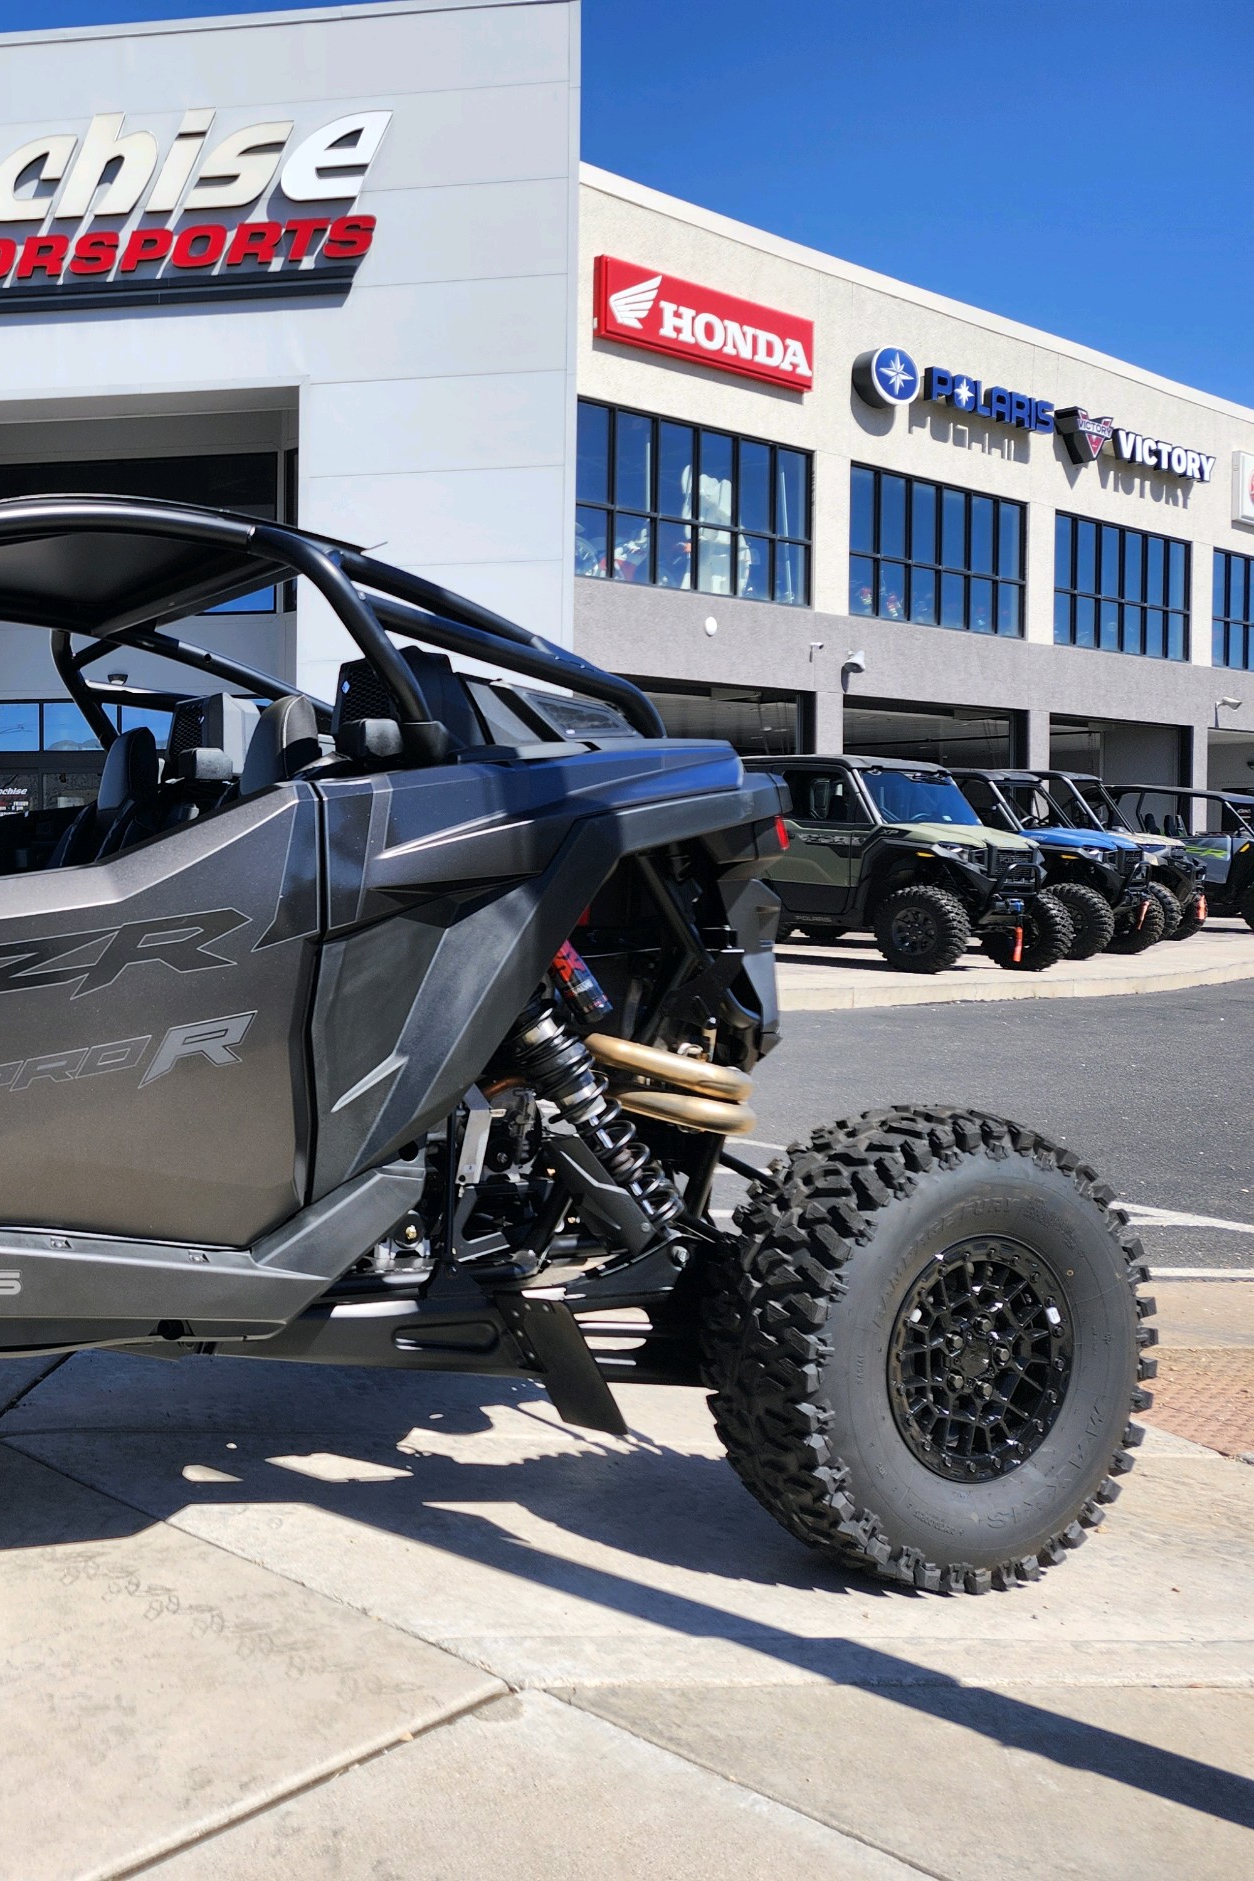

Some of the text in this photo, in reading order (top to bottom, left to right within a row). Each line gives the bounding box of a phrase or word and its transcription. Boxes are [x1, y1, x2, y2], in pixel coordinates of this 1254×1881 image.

[659, 300, 813, 378] HONDA
[925, 366, 1055, 434] POLARIS
[1077, 418, 1114, 440] VICTORY
[1115, 428, 1216, 482] VICTORY
[138, 1010, 257, 1089] R
